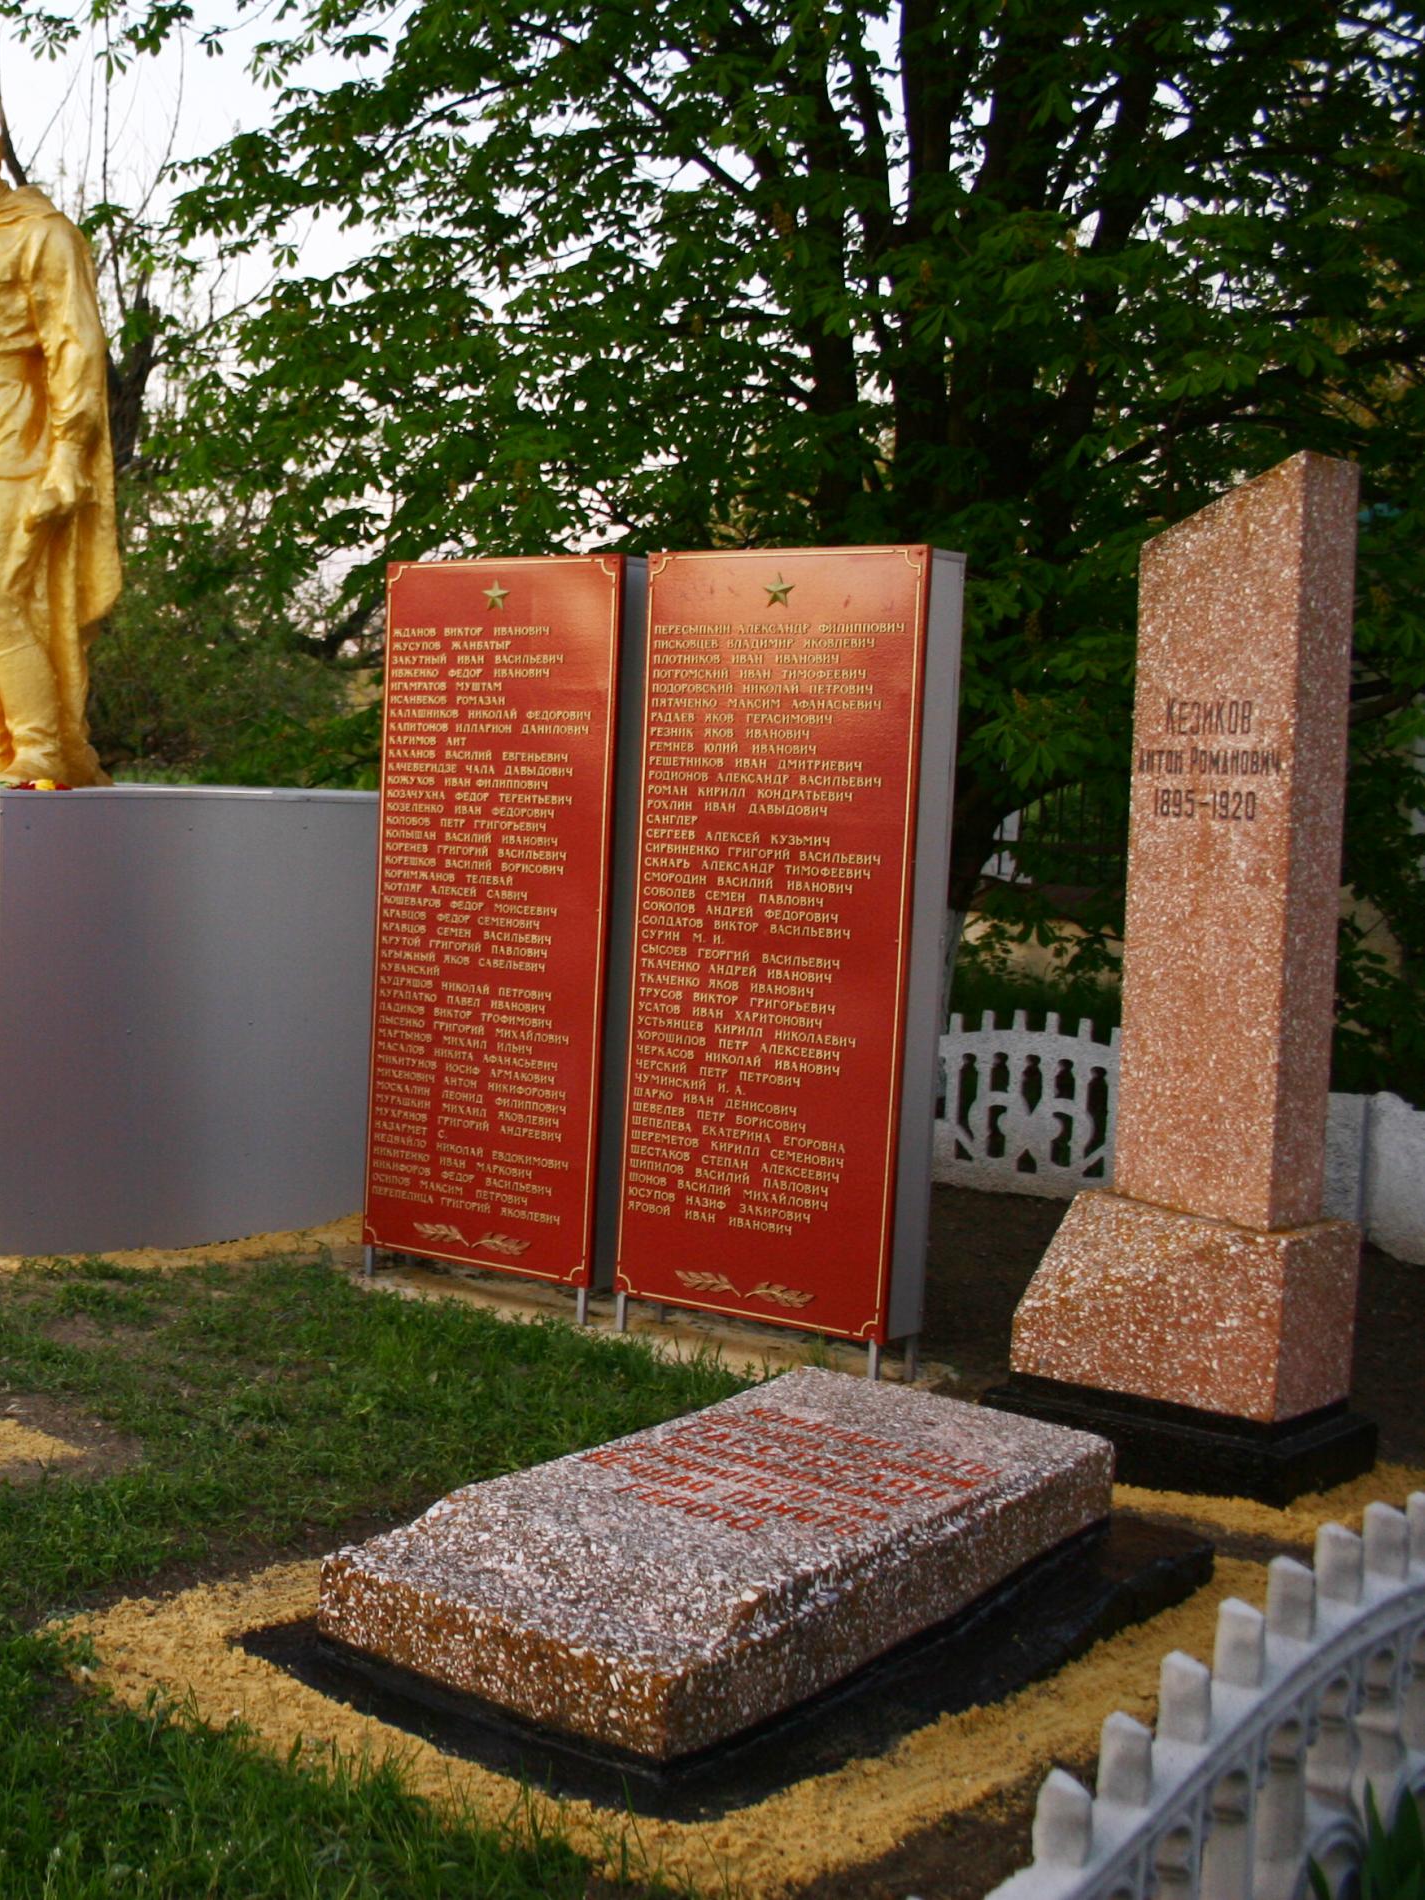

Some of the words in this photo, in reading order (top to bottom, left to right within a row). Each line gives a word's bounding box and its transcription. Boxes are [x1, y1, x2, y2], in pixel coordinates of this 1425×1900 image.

[392, 627, 436, 637] ЖДАНОВ
[443, 626, 483, 637] ВИКТОР
[493, 625, 549, 636] ИВАНОВИЧ
[391, 653, 447, 665] ЗАКУТНЫЙ
[456, 654, 484, 664] ИВАН
[494, 653, 563, 664] ВАСИЛЬЕВИЧ
[652, 666, 728, 679] ПОГРОМСКИЙ
[739, 669, 770, 679] ИВАН
[782, 669, 866, 679] ТИМОФЕЕВИЧ
[389, 708, 459, 719] КАЛАШНИКОВ
[467, 707, 517, 720] НИКОЛАЙ
[525, 709, 591, 721] ФЕДОРОВИЧ
[650, 711, 694, 723] РАДАЕВ
[704, 712, 734, 723] ЯКОВ
[745, 713, 832, 725] ГЕРАСИМОВИЧ
[1166, 697, 1253, 735] КЕЗИКОВ
[649, 726, 693, 737] РЕЗНИК
[703, 727, 734, 738] ЯКОВ
[745, 728, 810, 740] ИВАНОВИЧ
[388, 748, 436, 759] КАХАНОВ
[444, 747, 492, 761] ВАСИЛИЙ
[501, 751, 568, 763] ЕВГЕНЬЕВИЧ
[648, 755, 724, 768] РЕШЕТНИКОВ
[734, 757, 767, 769] ИВАН
[777, 758, 862, 772] ДМИТРИЕВИЧ
[1190, 747, 1281, 776] РОМАНОВИЧ
[386, 774, 435, 786] КОЖУХОВ
[444, 776, 471, 787] ИВАН
[475, 777, 548, 790] ФИЛИППОВИЧ
[647, 784, 688, 796] РОМАН
[697, 786, 746, 798] КИРИЛЛ
[756, 788, 853, 802] КОНДРАТЬЕВИЧ
[386, 801, 444, 814] КОЗЕЛЕНКО
[453, 804, 482, 815] ИВАН
[490, 805, 554, 819] ФЕДОРОВИЧ
[646, 798, 692, 811] РОХЛИН
[704, 801, 735, 813] ИВАН
[748, 803, 828, 817] ДАВЫДОВИЧ
[1154, 789, 1257, 821] 1895-1920
[645, 813, 698, 826] САНГЛЕР
[645, 827, 696, 840] СЕРГЕЕВ
[705, 828, 760, 844] АЛЕКСЕЙ
[770, 833, 830, 847] КУЗЬМИЧ
[384, 841, 428, 853] КОРЕНЕВ
[436, 842, 488, 857] ГРИГОРИЙ
[497, 847, 567, 861] ВАСИЛЬЕВИЧ
[383, 880, 422, 893] КОТЛЯР
[430, 882, 477, 897] АЛЕКСЕЙ
[486, 888, 527, 901] САВВИЧ
[643, 871, 707, 885] СМОРОДИН
[716, 873, 773, 889] ВАСИЛИЙ
[786, 879, 853, 894] ИВАНОВИЧ
[642, 885, 696, 899] СОБОЛЕВ
[704, 889, 745, 902] СЕМЕН
[758, 893, 824, 908] ПАВЛОВИЧ
[642, 899, 696, 914] СОКОЛОВ
[705, 902, 753, 918] АНДРЕЙ
[763, 908, 838, 924] ФЕДОРОВИЧ
[382, 921, 426, 934] КРАВЦОВ
[436, 925, 471, 938] СЕМЕН
[482, 930, 552, 945] ВАСИЛЬЕВИЧ
[381, 932, 421, 947] КРУТОЙ
[428, 936, 482, 953] ГРИГОРИЙ
[490, 944, 547, 959] ПАВЛОВИЧ
[640, 942, 687, 957] СЫСОЕВ
[697, 945, 750, 962] ГЕОРГИЙ
[761, 952, 840, 970] ВАСИЛЬЕВИЧ
[640, 957, 701, 972] ТКАЧЕНКО
[708, 960, 757, 978] АНДРЕЙ
[766, 968, 832, 984] ИВАНОВИЧ
[446, 994, 480, 1008] ПАВЕЛ
[490, 999, 545, 1014] ИВАНОВИЧ
[639, 986, 683, 1000] ТРУСОВ
[692, 991, 738, 1006] ВИКТОР
[749, 996, 835, 1015] ГРИГОРЬЕВИЧ
[638, 1000, 681, 1015] УСАТОВ
[691, 1006, 723, 1019] ИВАН
[734, 1010, 822, 1029] ХАРИТОНОВИЧ
[378, 1014, 425, 1029] ЛЫСЕНКО
[432, 1018, 485, 1036] ГРИГОРИЙ
[494, 1025, 569, 1045] МИХАЙЛОВИЧ
[635, 1043, 694, 1060] ЧЕРКАСОВ
[704, 1049, 761, 1067] НИКОЛАЙ
[774, 1059, 840, 1076] ИВАНОВИЧ
[376, 1080, 430, 1096] МОСКАЛИН
[441, 1088, 483, 1104] ЛЕОНИД
[494, 1096, 566, 1115] ФИЛИППОВИЧ
[633, 1086, 674, 1101] ШАРКО
[682, 1092, 714, 1106] ИВАН
[724, 1097, 797, 1117] ДЕНИСОВИЧ
[632, 1100, 685, 1117] ШЕВЕЛЕВ
[696, 1108, 725, 1123] ПЕТР
[735, 1114, 806, 1133] БОРИСОВИЧ
[630, 1143, 691, 1162] ШЕСТАКОВ
[700, 1153, 748, 1170] СТЕПАН
[760, 1162, 840, 1183] АЛЕКСЕЕВИЧ
[745, 1407, 903, 1450] КОМАНДИР
[909, 1449, 1003, 1478] РОТЫ
[676, 1424, 949, 1500] РАССТРЕЛЯН
[578, 1450, 716, 1494] ВЕЧНАЯ
[719, 1490, 864, 1537] ПАМЯТЬ
[734, 1474, 821, 1501] 1920
[611, 1483, 766, 1531] ГЕРОЮ
